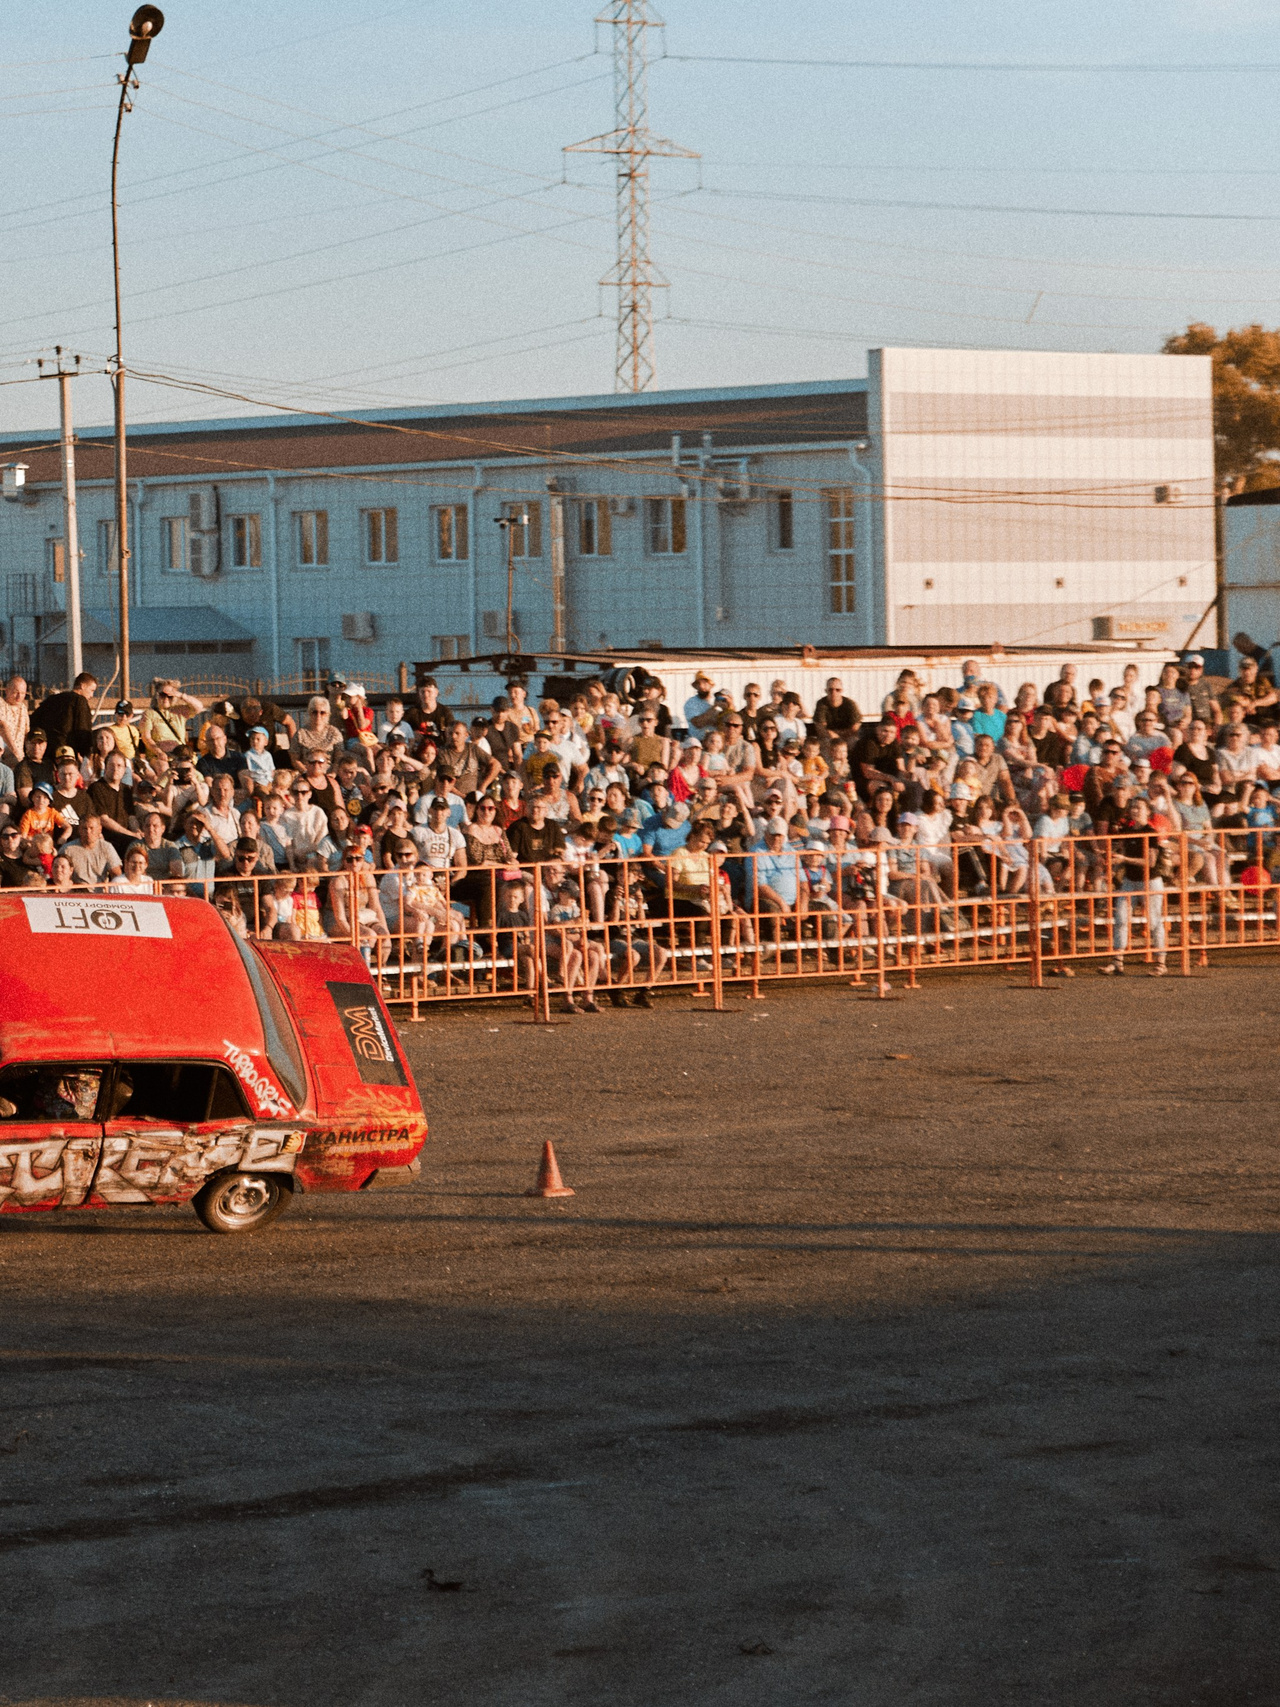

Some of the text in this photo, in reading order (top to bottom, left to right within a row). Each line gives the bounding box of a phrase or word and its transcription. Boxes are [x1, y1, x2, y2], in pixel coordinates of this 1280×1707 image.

[84, 901, 134, 909] КОМФОРТ
[54, 908, 141, 932] LOFT
[344, 1006, 386, 1061] DM
[311, 1128, 410, 1145] КАНИСТРА
